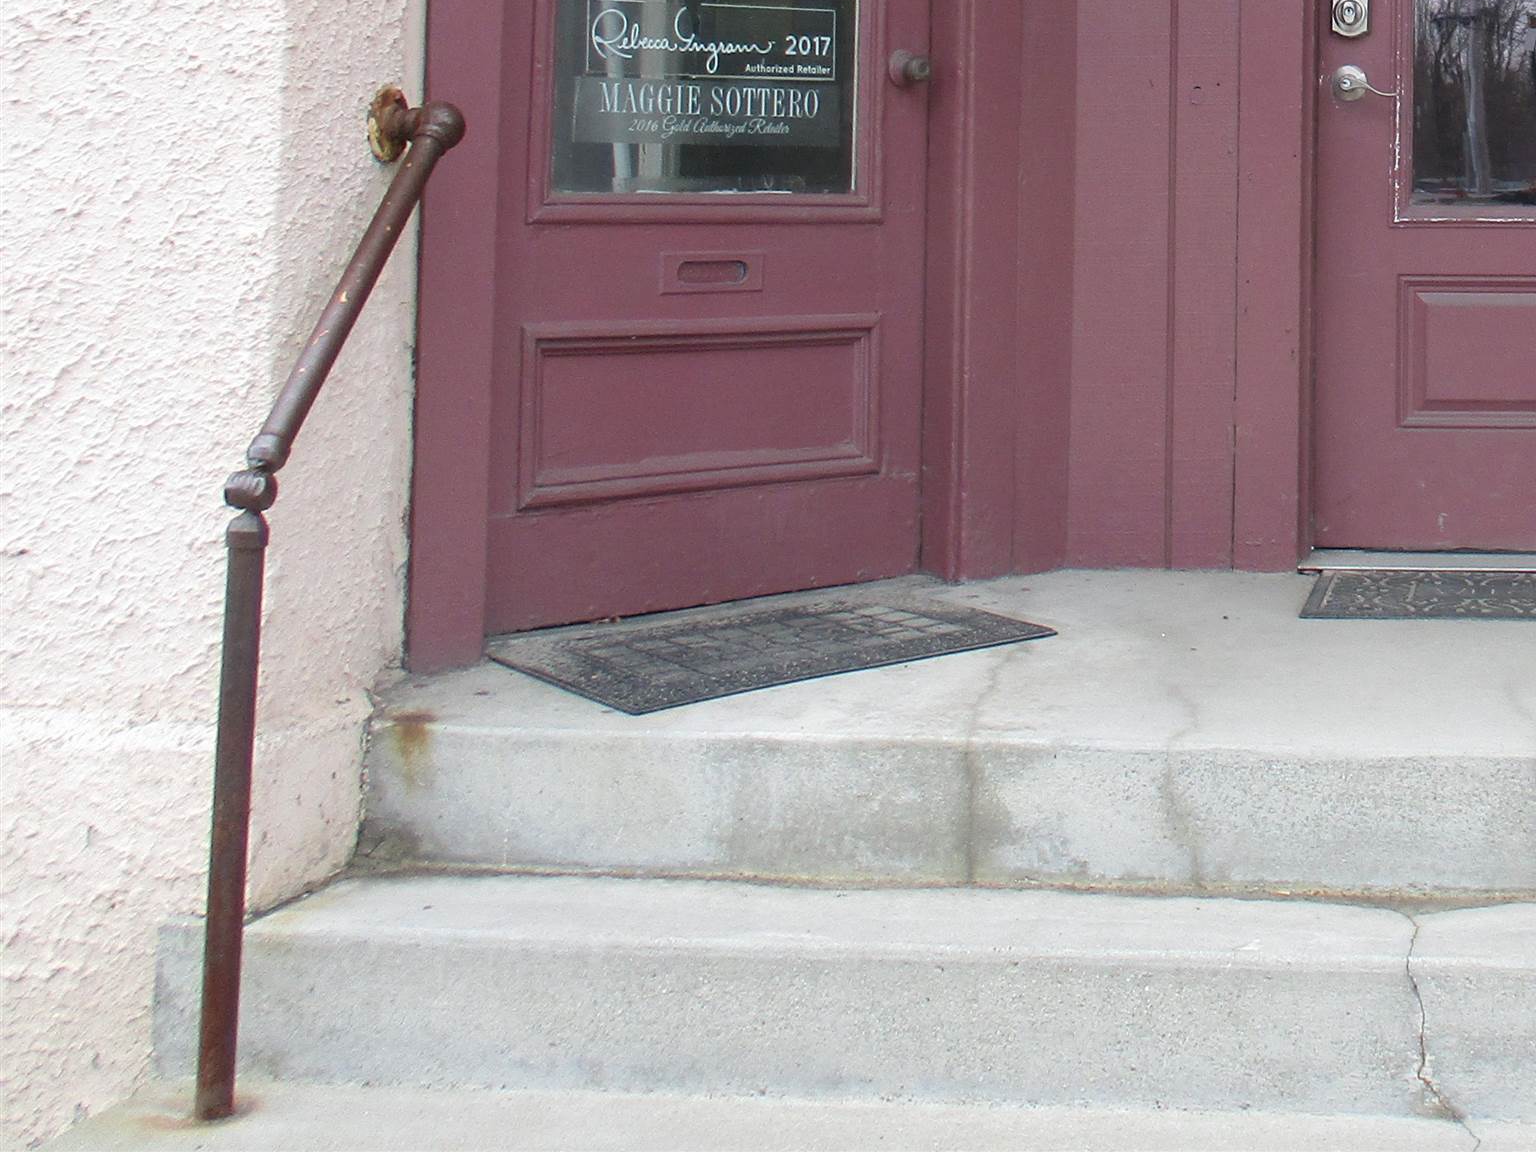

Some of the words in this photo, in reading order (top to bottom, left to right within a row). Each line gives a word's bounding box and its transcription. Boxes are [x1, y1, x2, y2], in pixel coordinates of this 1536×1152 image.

[591, 8, 678, 60] Rebecca
[785, 35, 832, 57] 2017
[745, 63, 795, 74] Authorized
[797, 63, 832, 75] Retailer
[598, 81, 701, 116] MAGGIE
[710, 86, 819, 119] SOTTERO
[628, 119, 659, 133] 2016
[660, 114, 691, 139] Gold
[693, 117, 746, 138] Authorized
[747, 117, 791, 135] Retailer
